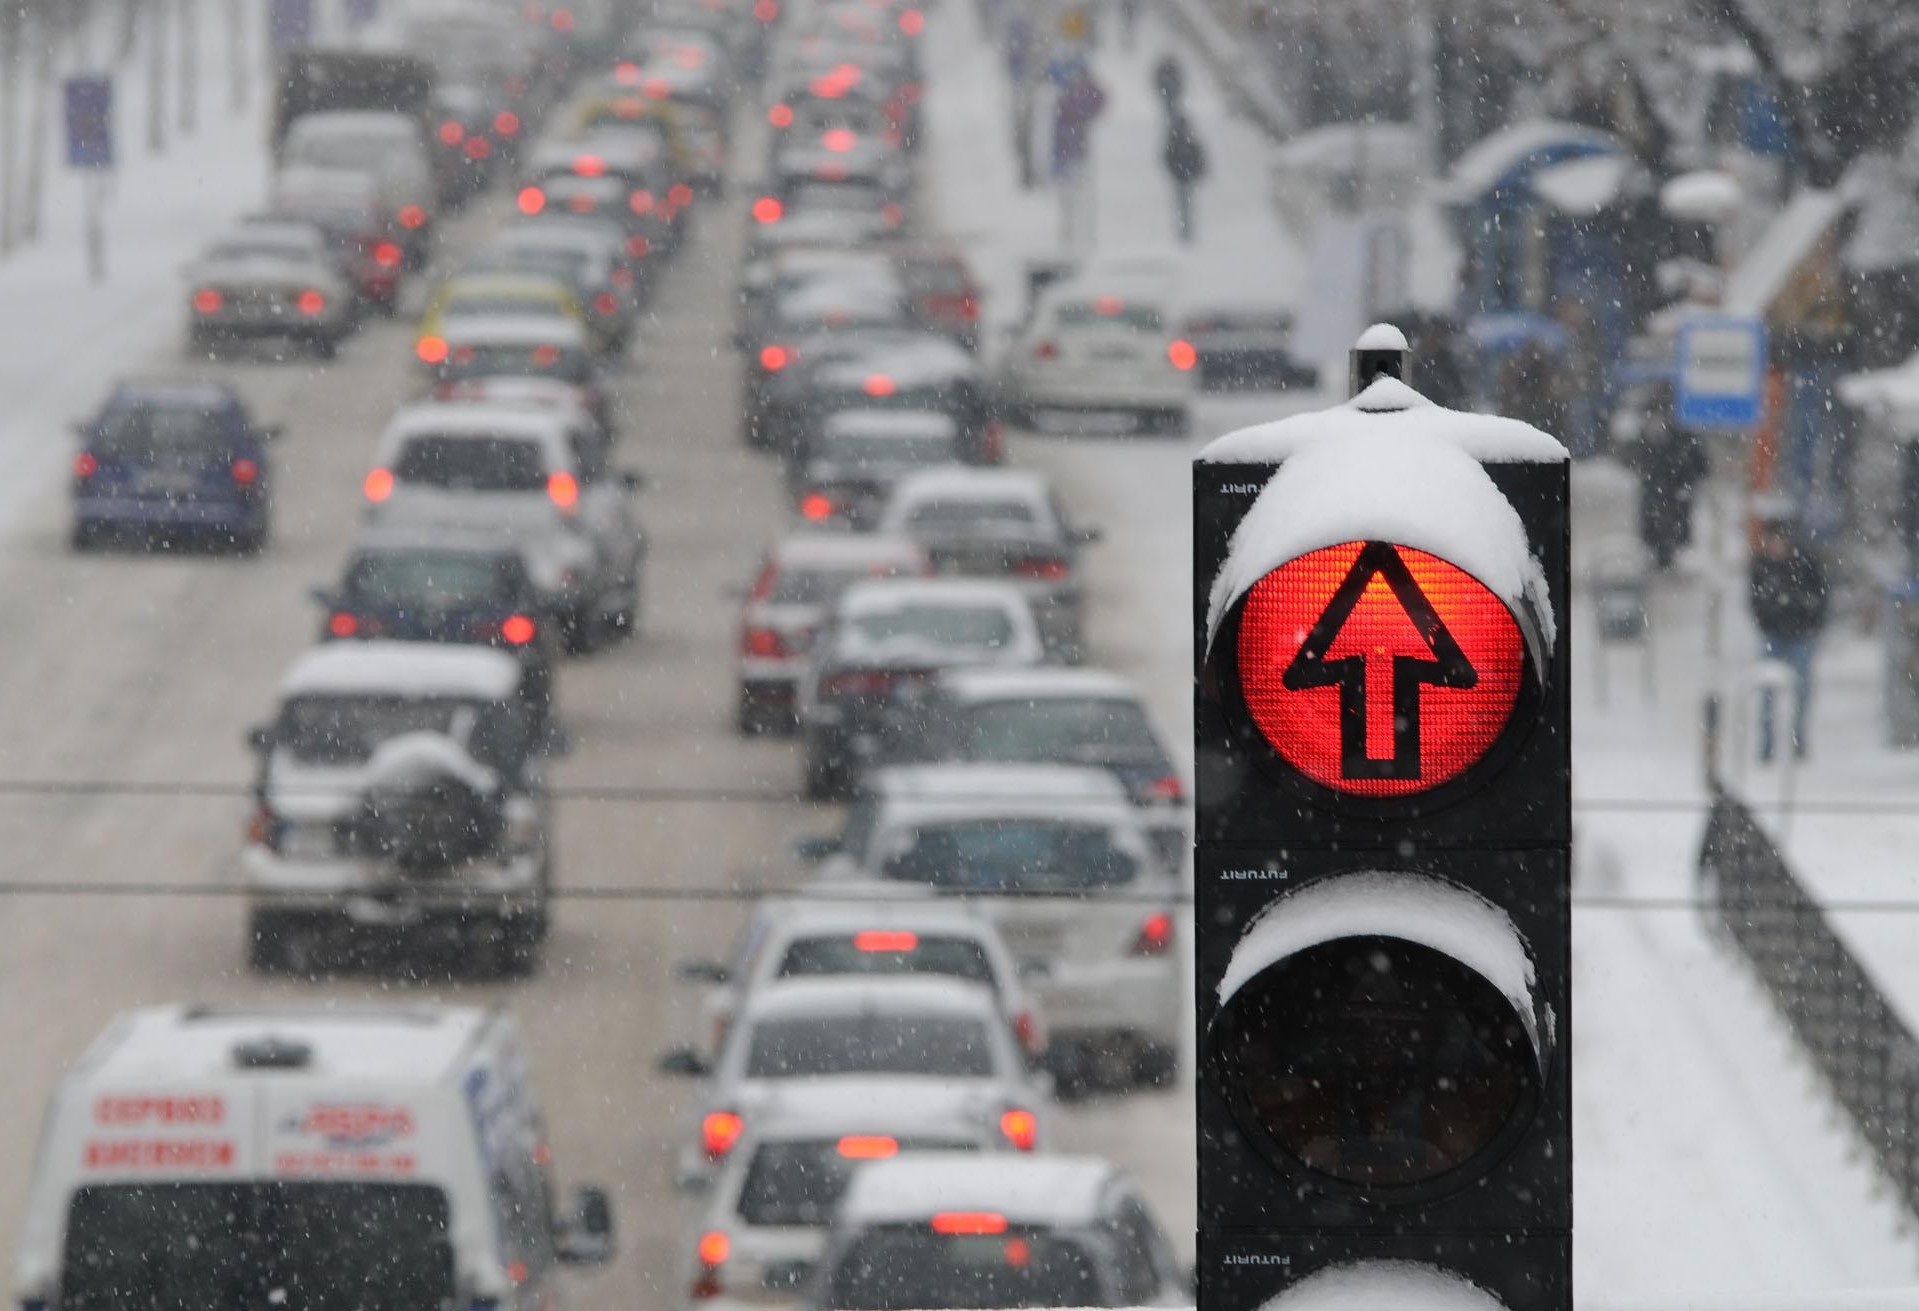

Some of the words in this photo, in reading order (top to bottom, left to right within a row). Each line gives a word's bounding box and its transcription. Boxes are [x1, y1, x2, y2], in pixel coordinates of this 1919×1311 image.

[1219, 483, 1262, 494] URIT
[1220, 869, 1288, 880] FUTURIT
[1223, 1254, 1291, 1265] FUTURIT
